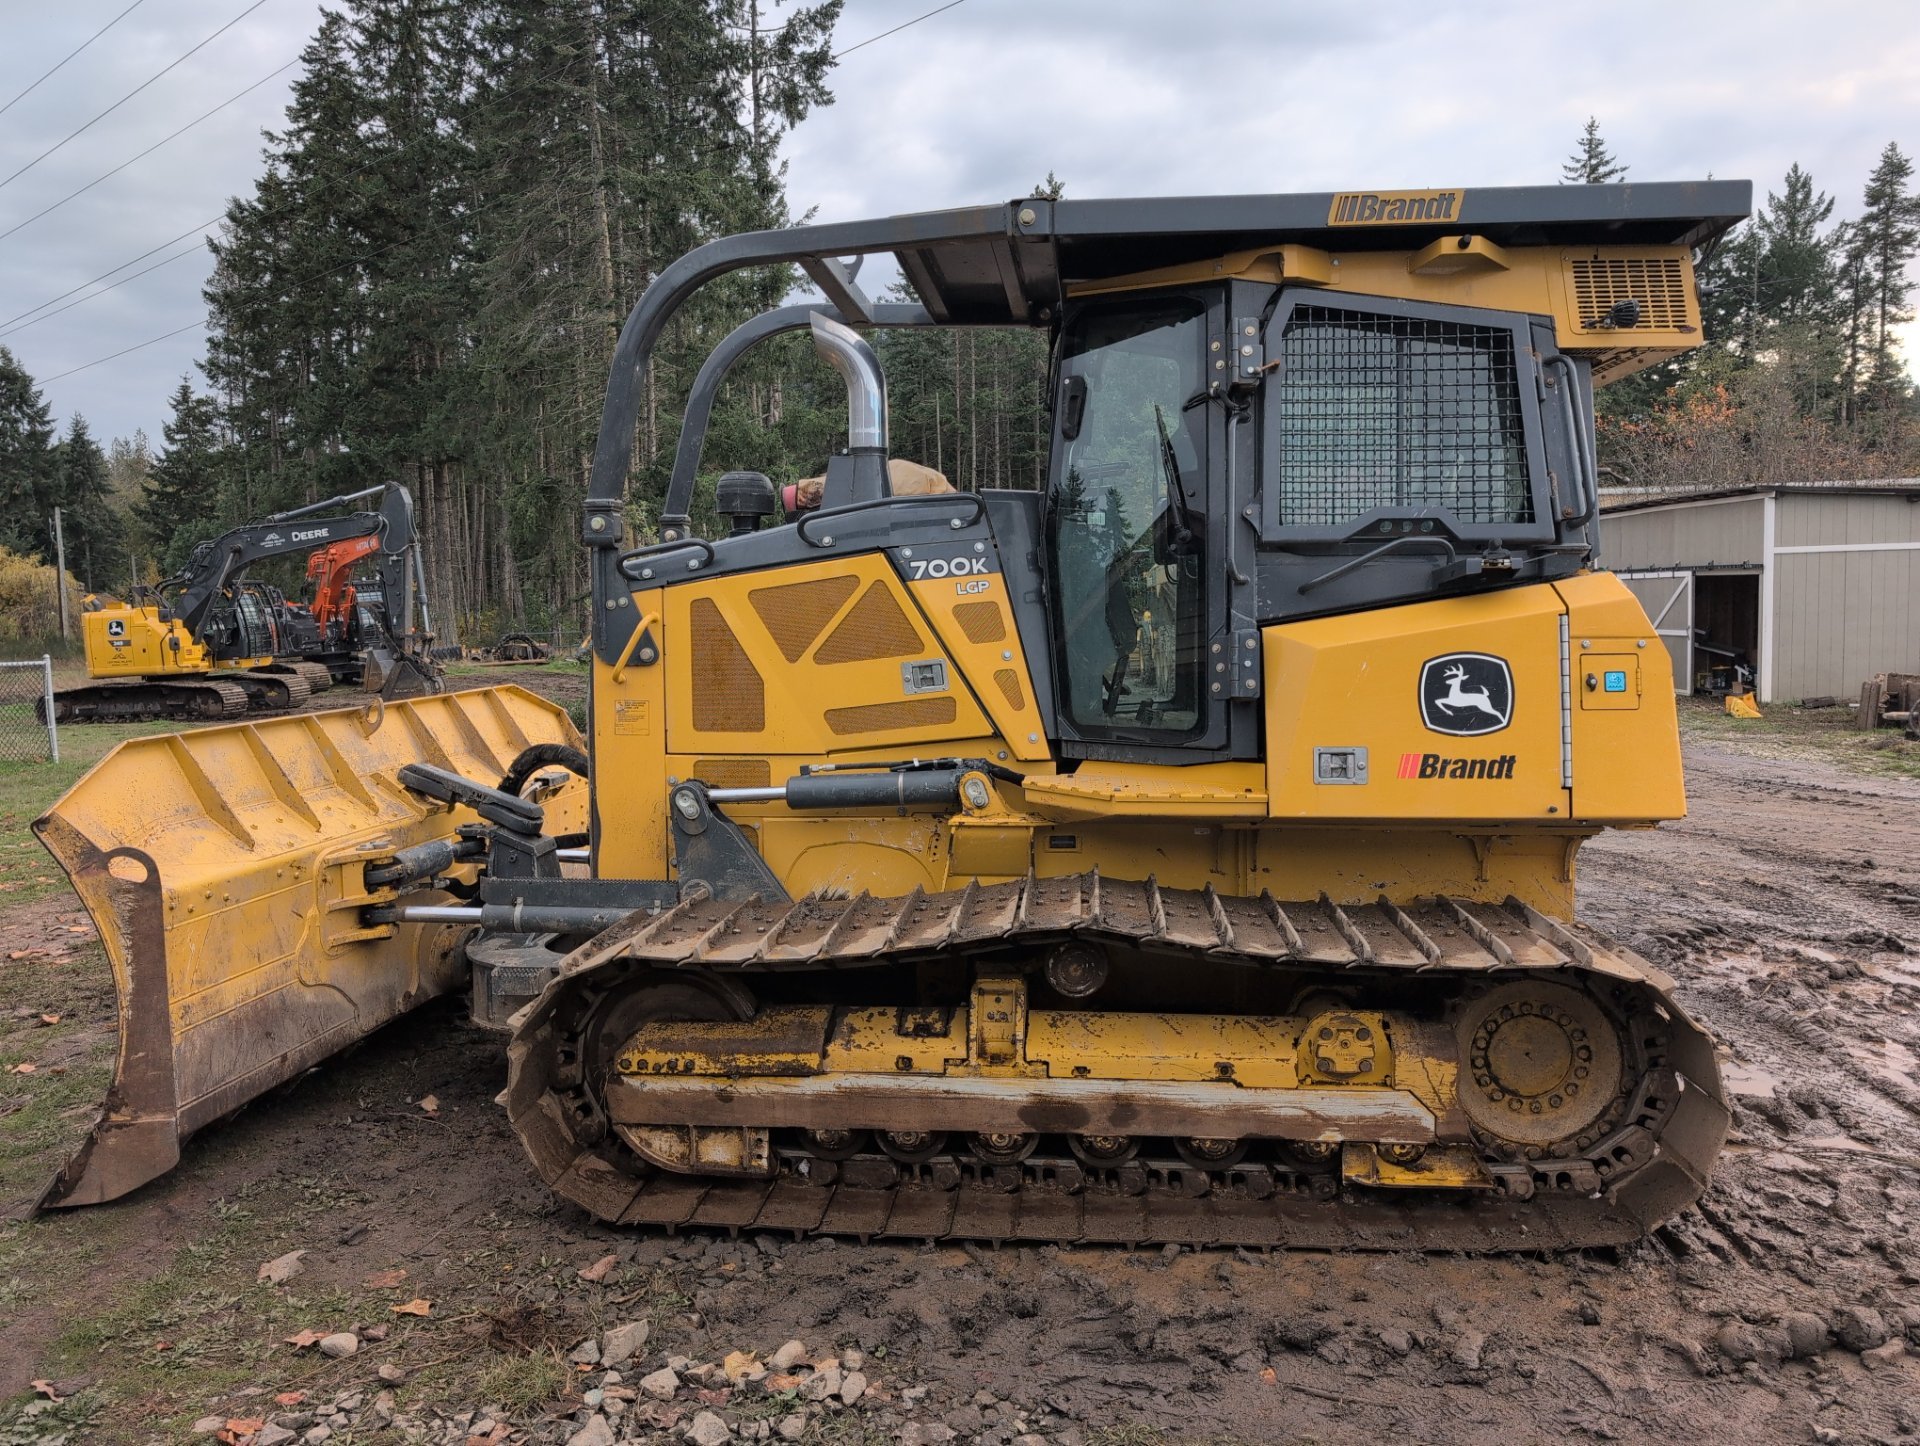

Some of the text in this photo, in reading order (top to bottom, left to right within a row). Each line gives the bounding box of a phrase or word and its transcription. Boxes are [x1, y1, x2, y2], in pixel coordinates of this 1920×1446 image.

[1356, 193, 1455, 221] Brandt
[291, 528, 330, 541] DEERE
[909, 557, 989, 580] 700K
[955, 580, 990, 596] LGP
[1418, 753, 1517, 780] Brandt
